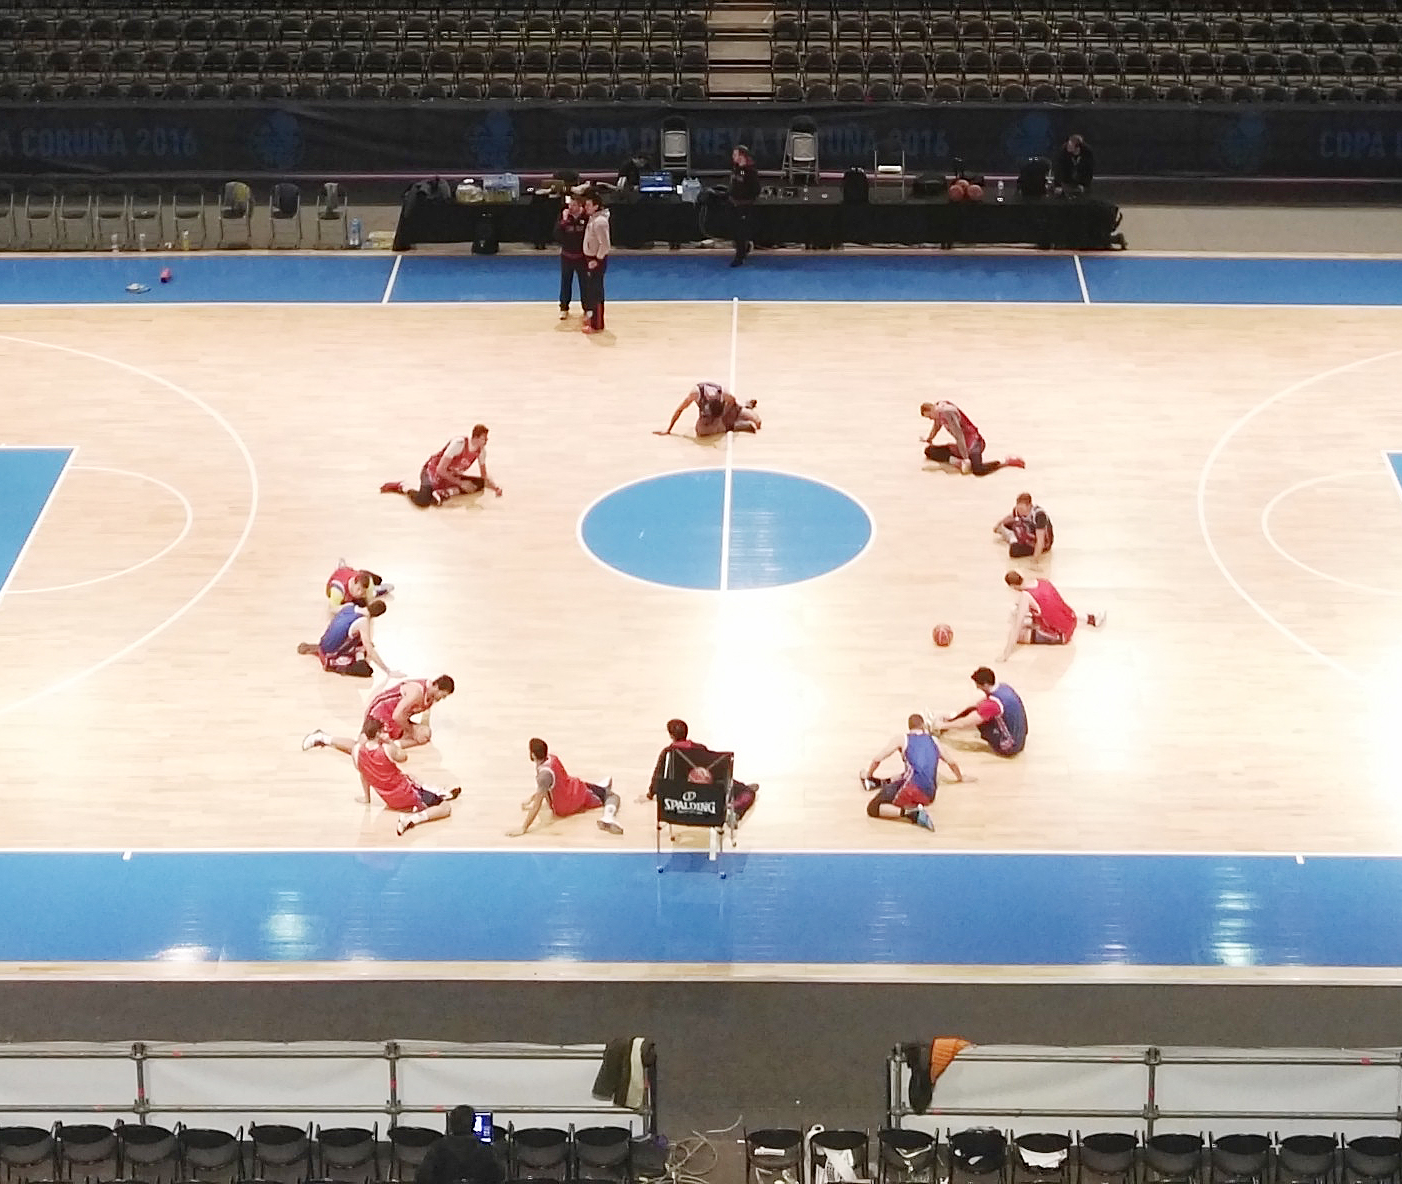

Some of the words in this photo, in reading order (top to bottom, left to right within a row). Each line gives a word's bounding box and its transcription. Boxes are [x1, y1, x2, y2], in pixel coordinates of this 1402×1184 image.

[21, 121, 128, 157] CORUÑA
[134, 127, 197, 157] 2016
[566, 128, 631, 155] COPA
[1319, 130, 1386, 159] COPA
[664, 798, 716, 815] SPALDING
